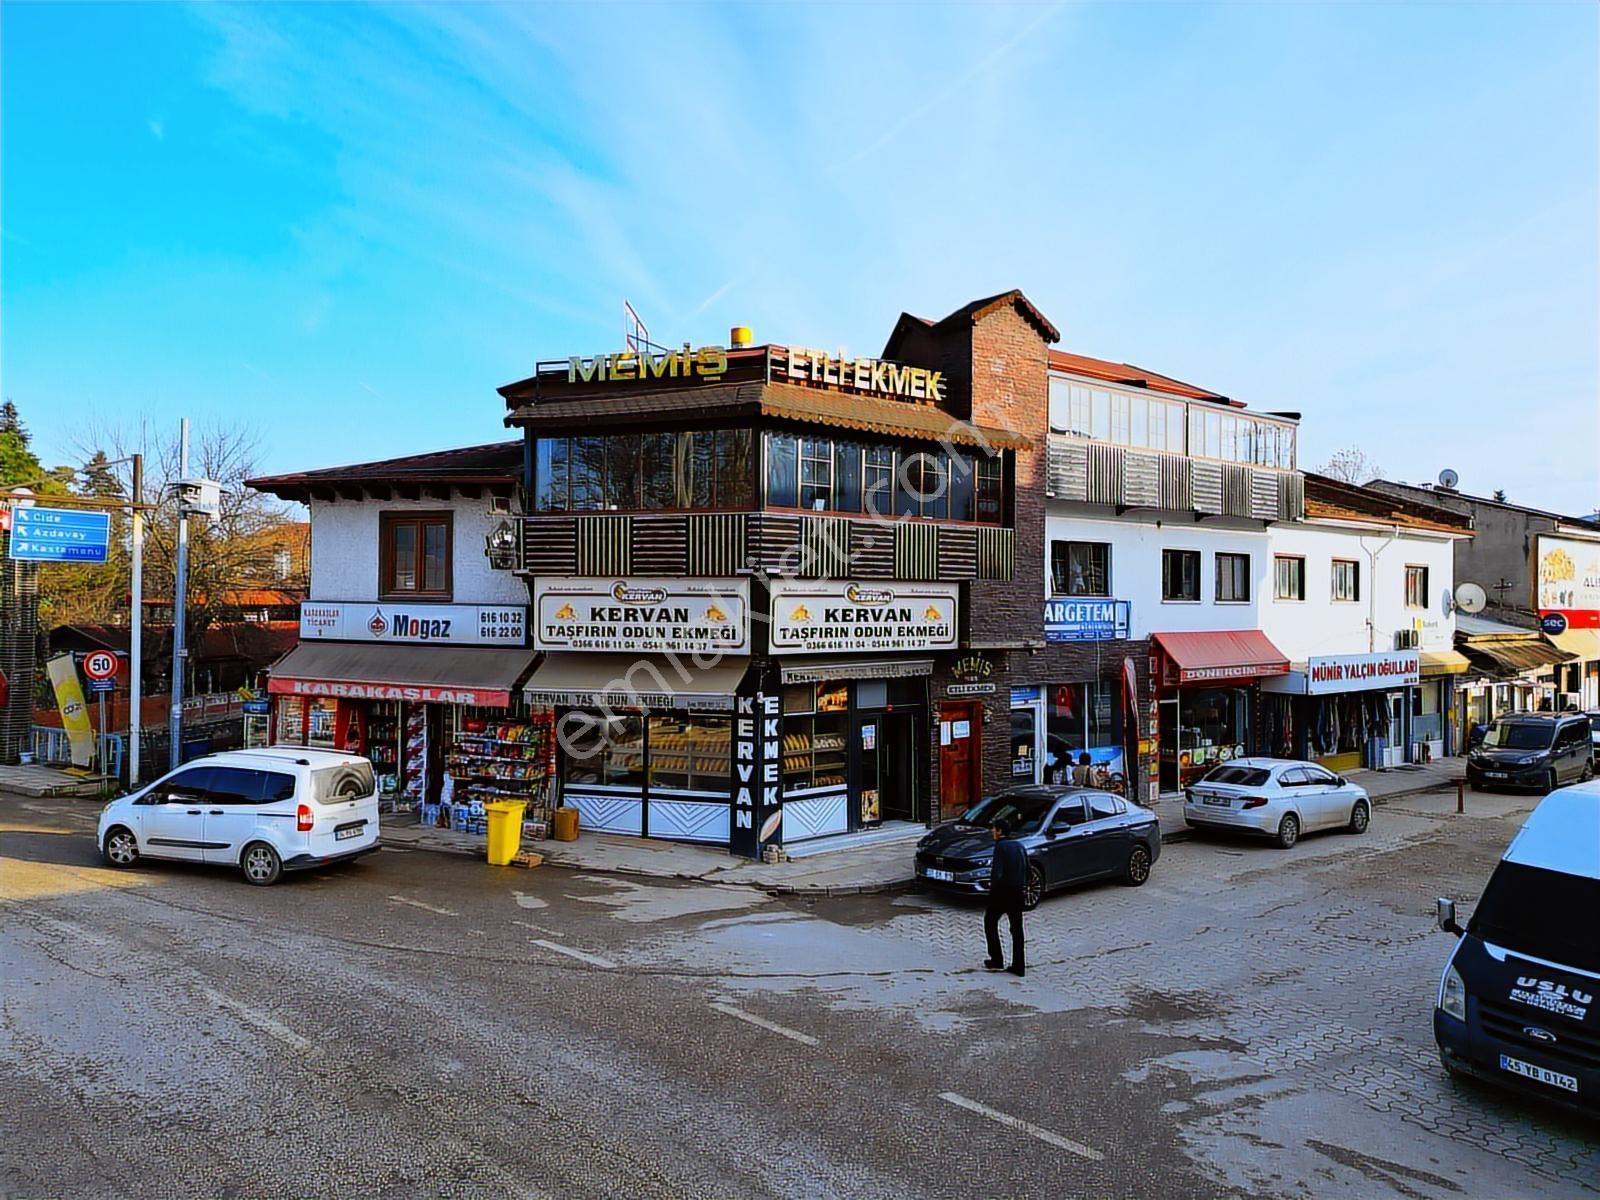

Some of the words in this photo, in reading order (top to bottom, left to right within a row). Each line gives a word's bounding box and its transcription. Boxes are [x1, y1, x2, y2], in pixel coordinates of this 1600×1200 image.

[854, 357, 943, 400] EKMEK
[33, 513, 61, 522] Cide
[33, 528, 86, 540] Azdavay
[481, 612, 497, 623] 616
[499, 612, 510, 623] 10
[511, 612, 522, 623] 32
[591, 607, 689, 622] KERVAN
[824, 608, 912, 622] KERVAN
[393, 614, 451, 640] Mogaz
[481, 627, 497, 638] 616
[498, 627, 510, 638] 22
[511, 627, 522, 638] 00
[546, 625, 617, 640] TAŞFIRIN
[622, 626, 666, 638] ODUN
[672, 625, 737, 640] EKMEĞİ
[779, 626, 849, 641] TAŞFIRIN
[854, 626, 893, 638] ODUN
[897, 624, 949, 637] EKMEĞİ
[613, 641, 622, 649] 11
[845, 641, 853, 649] 11
[92, 658, 110, 671] 50
[1312, 661, 1343, 682] MÜNİR
[1344, 663, 1377, 680] YALÇIN
[1378, 658, 1418, 677] OĞULLARI
[764, 696, 779, 806] EKMEK
[737, 696, 754, 829] KERVAN
[1516, 976, 1593, 1004] USLU
[1507, 1058, 1521, 1072] 45
[1524, 1064, 1539, 1078] YB
